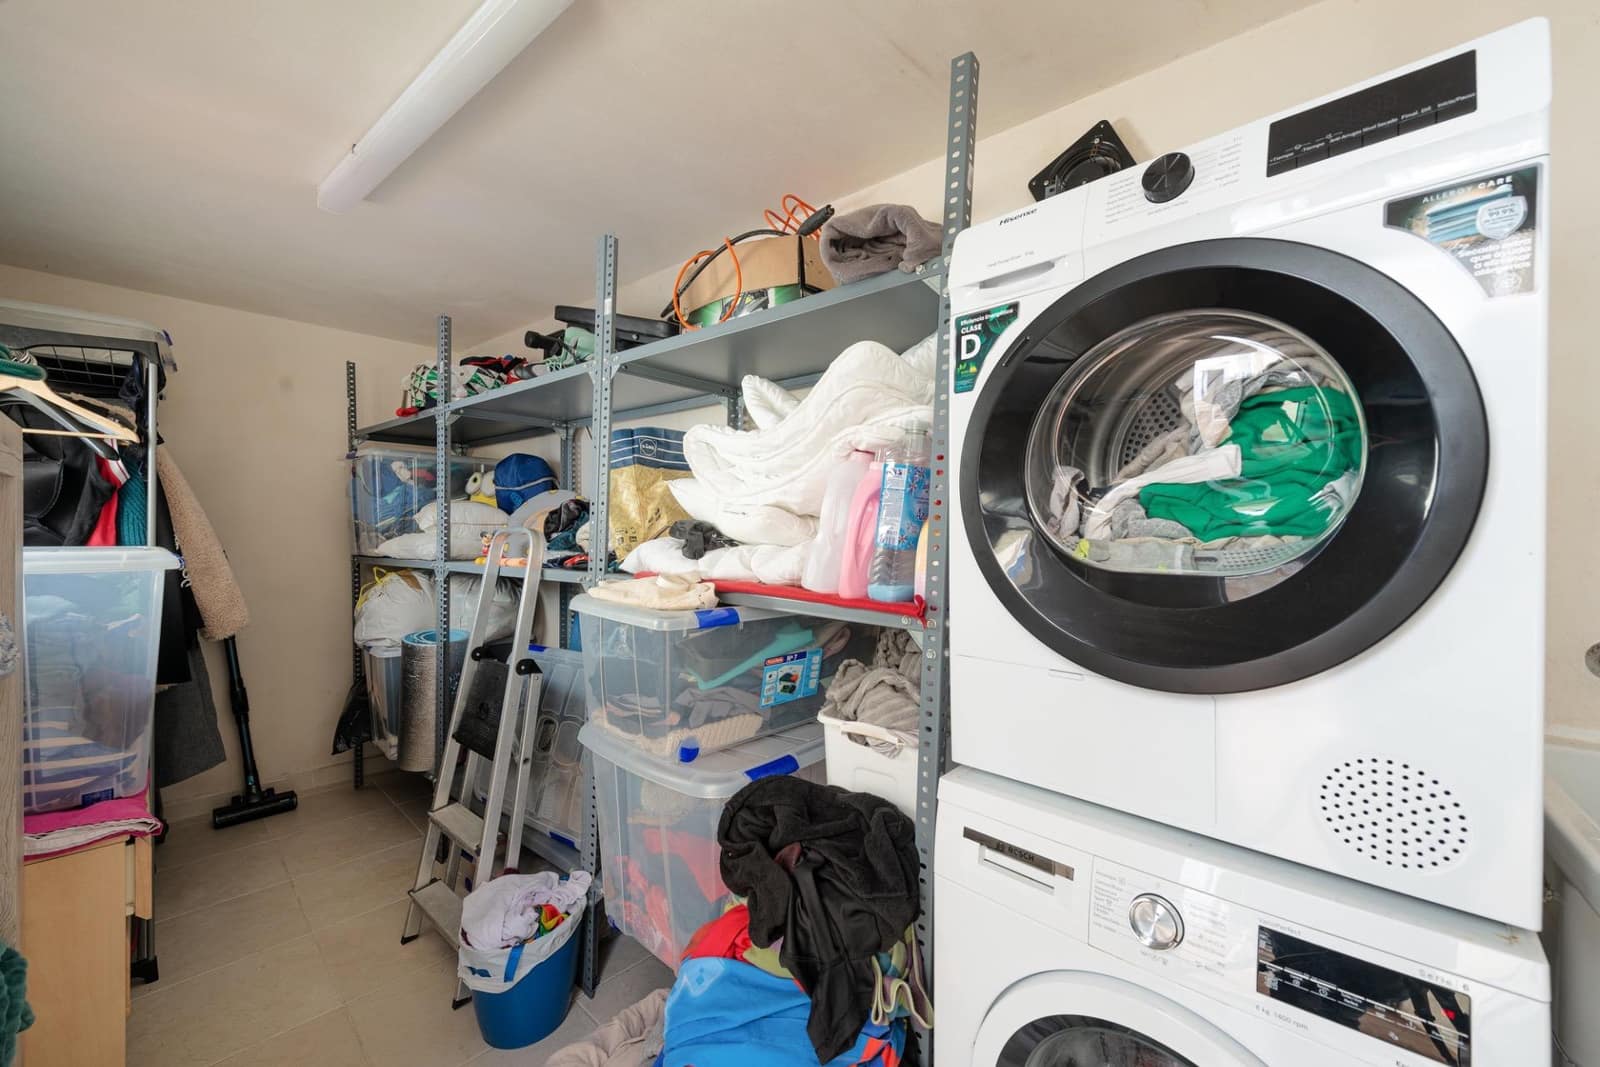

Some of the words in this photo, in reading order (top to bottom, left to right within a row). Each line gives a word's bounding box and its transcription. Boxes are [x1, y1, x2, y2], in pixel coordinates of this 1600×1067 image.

[1423, 187, 1472, 203] ALLERGY
[1478, 176, 1512, 189] CARE
[999, 208, 1038, 226] Hisense
[960, 323, 982, 335] CLASE
[960, 333, 982, 361] D
[1007, 845, 1035, 862] BOSCH
[1419, 969, 1452, 986] Serie
